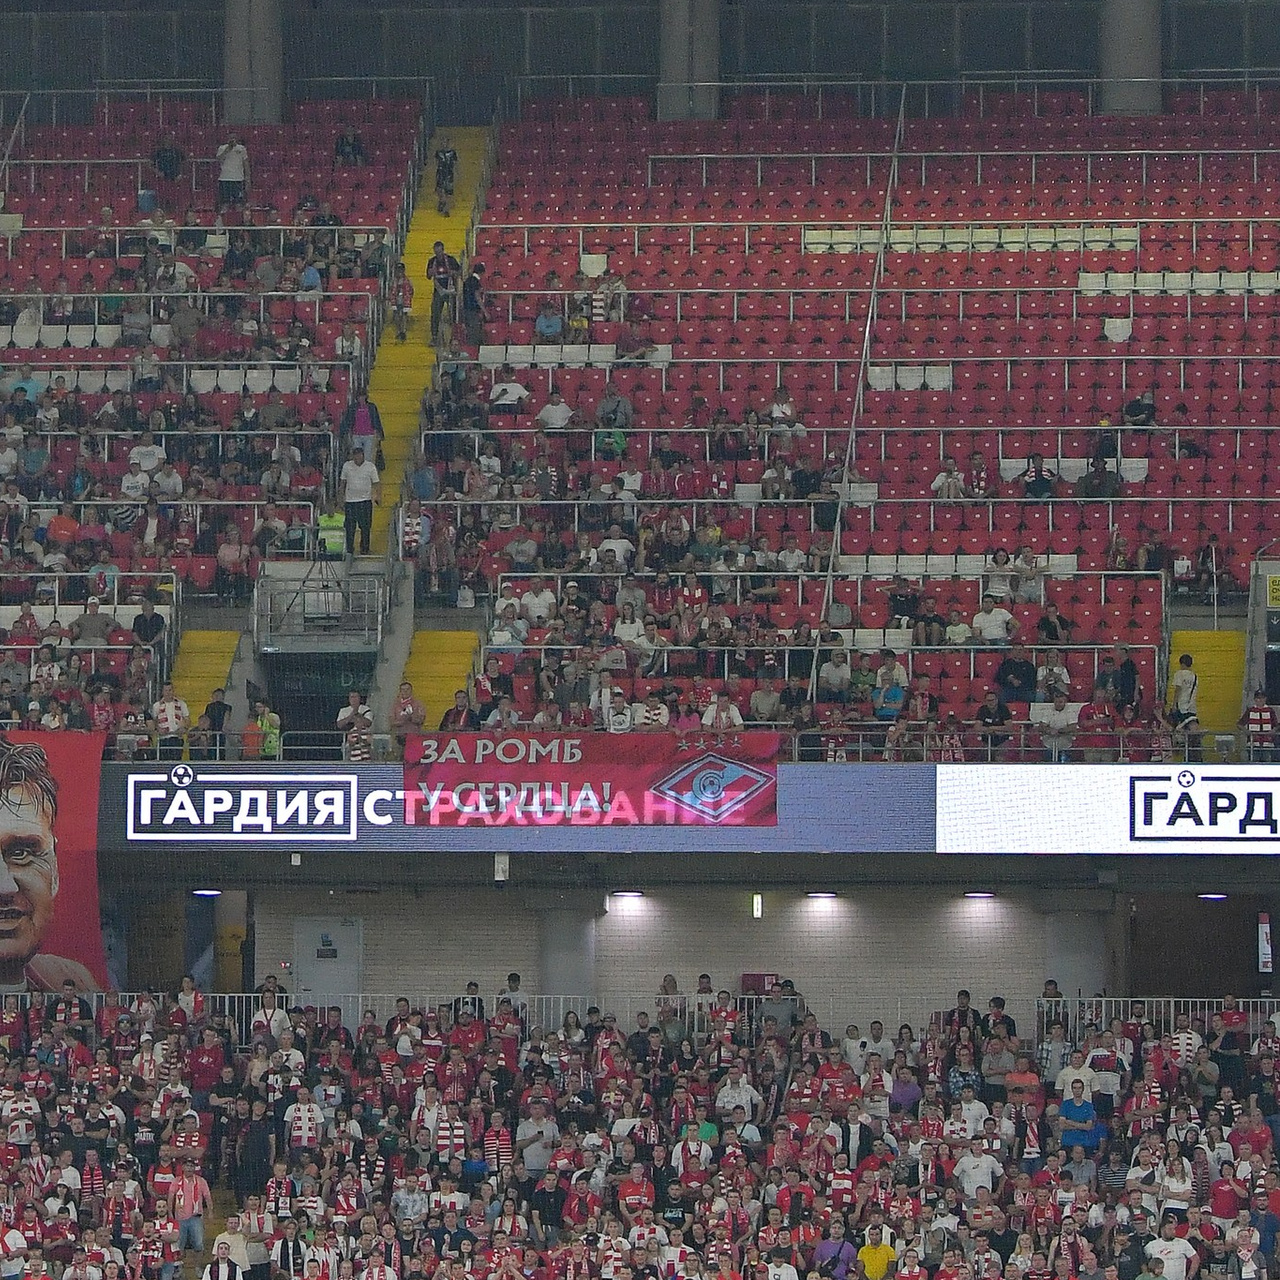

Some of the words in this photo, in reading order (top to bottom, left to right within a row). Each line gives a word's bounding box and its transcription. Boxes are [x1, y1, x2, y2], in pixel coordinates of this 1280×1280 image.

[418, 739, 465, 765] ЗА
[473, 738, 583, 765] РОМБ
[139, 789, 337, 835] ГАРДИЯ
[419, 781, 444, 813] У
[451, 781, 613, 819] СЕРДЦА!
[1143, 791, 1279, 835] ГАРД
